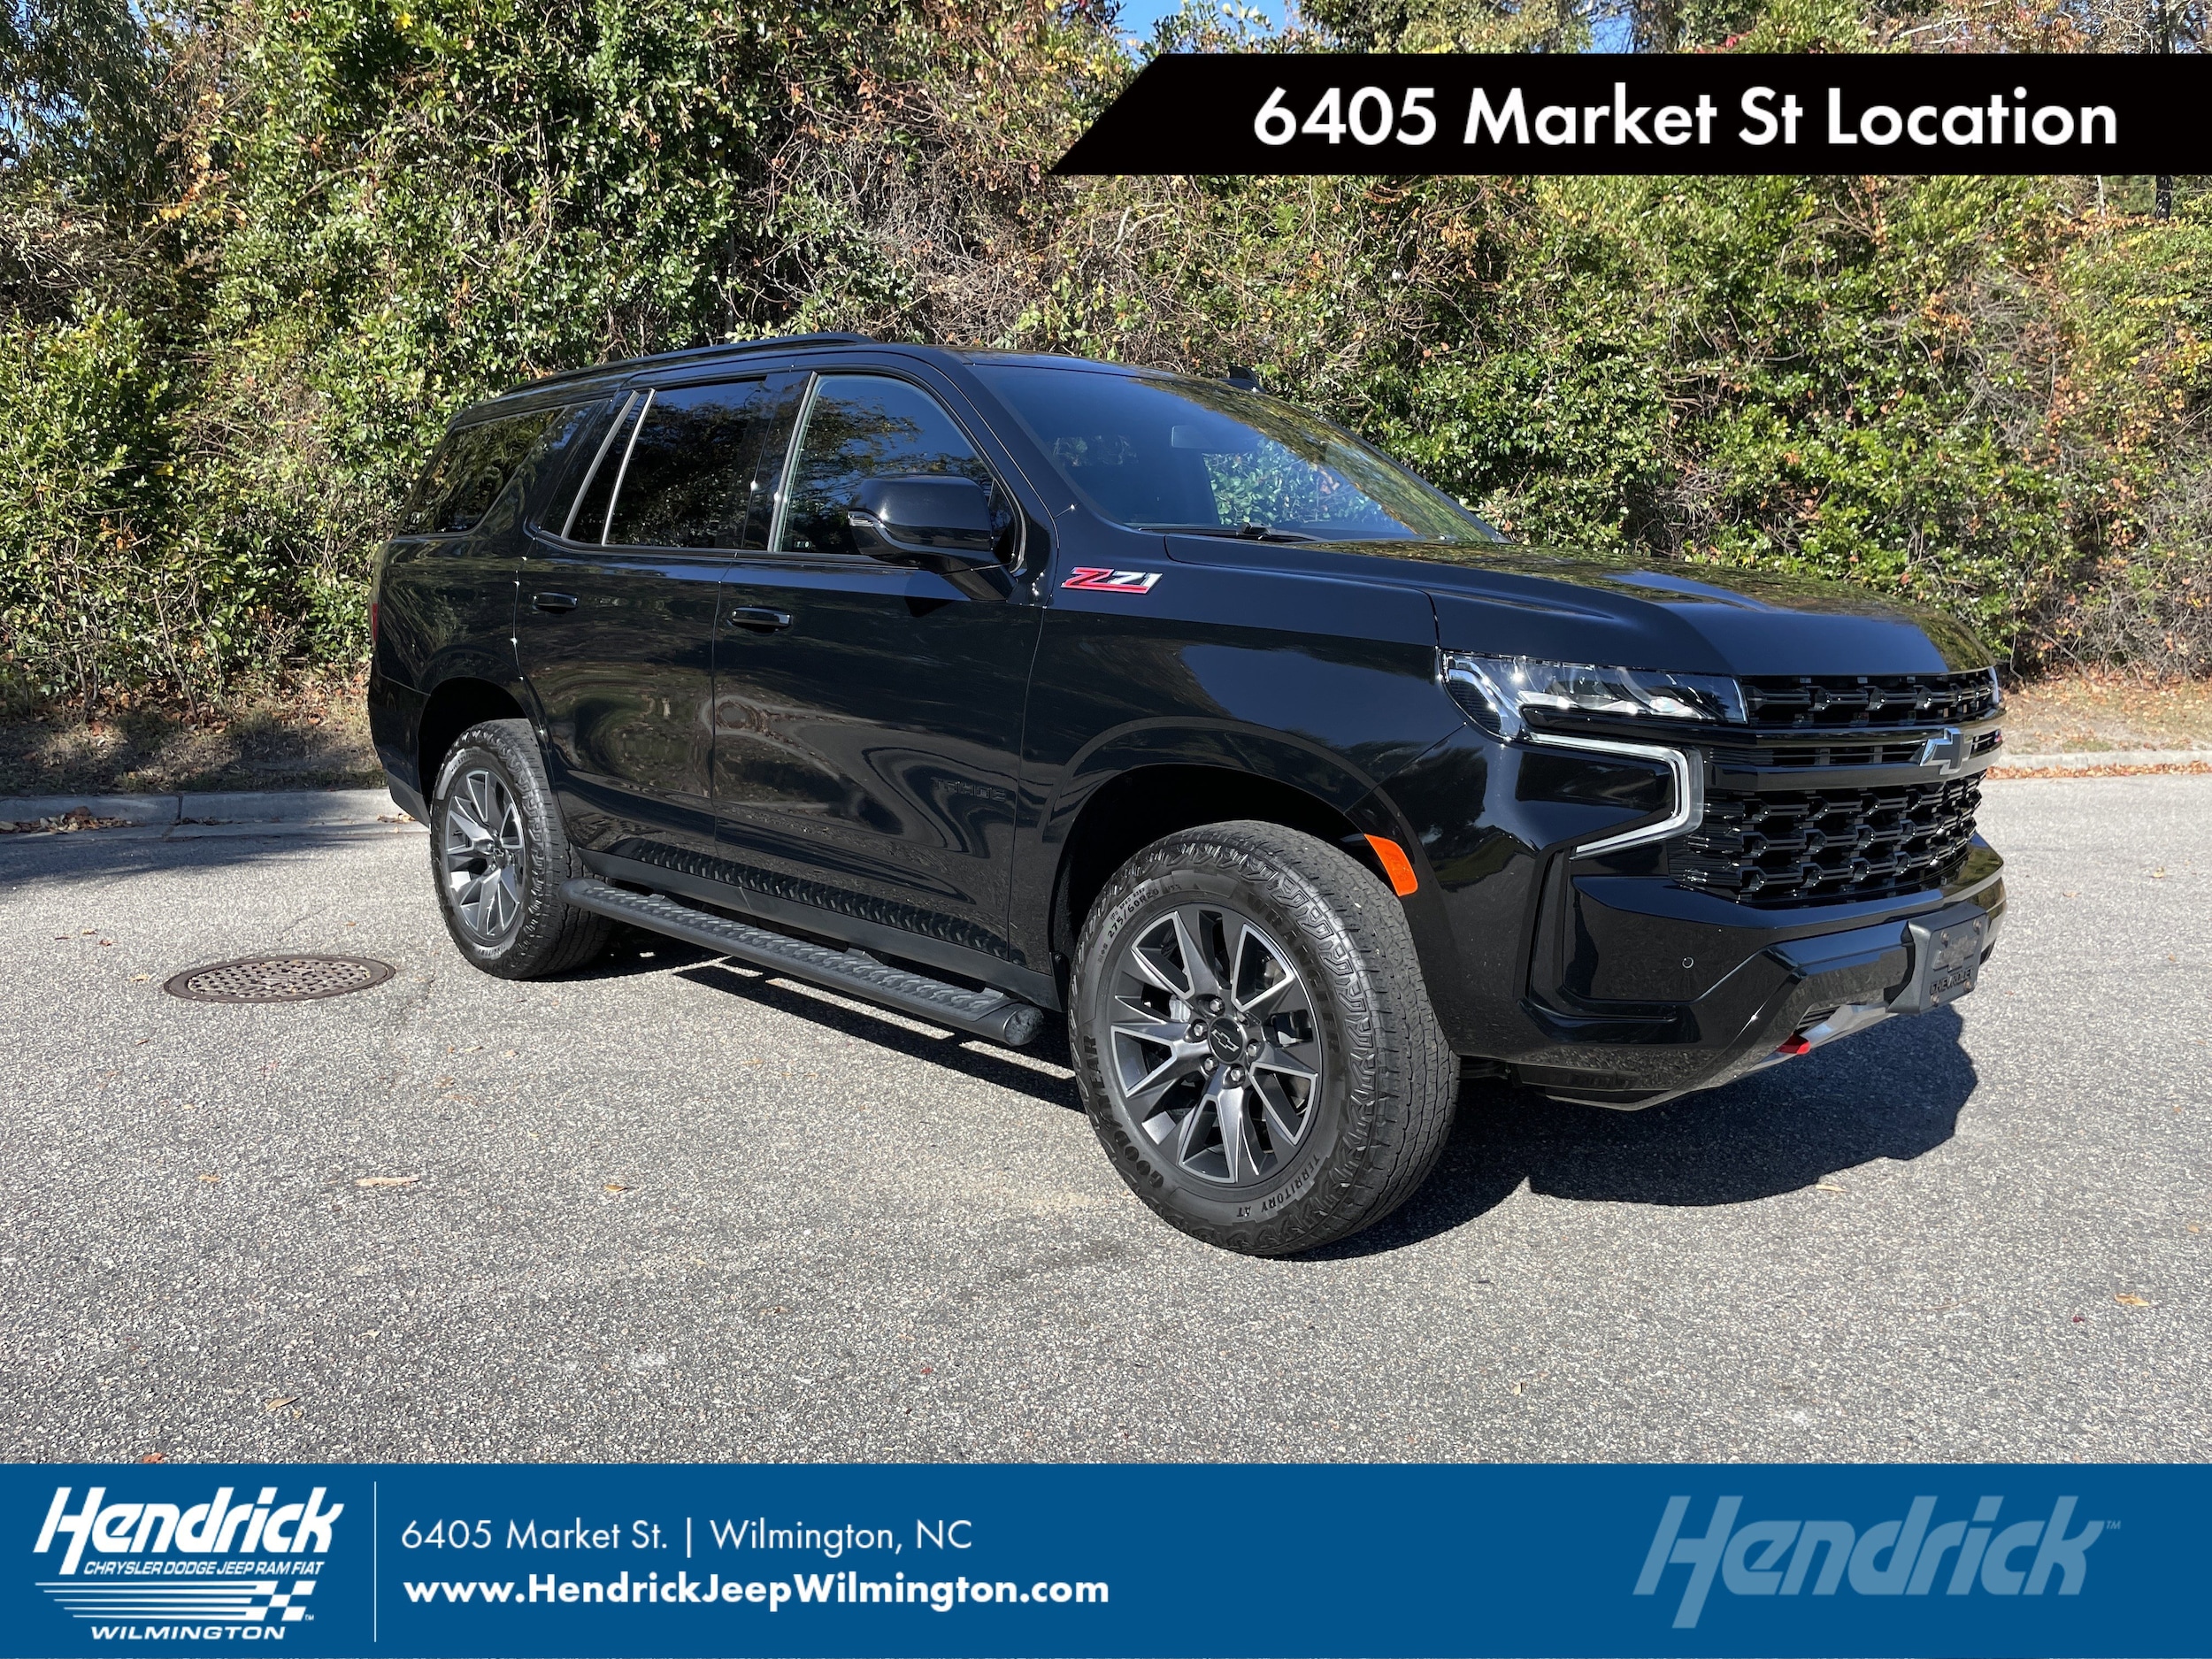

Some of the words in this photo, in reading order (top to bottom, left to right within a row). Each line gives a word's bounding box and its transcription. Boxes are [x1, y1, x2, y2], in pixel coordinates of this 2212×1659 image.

[1061, 566, 1164, 595] Z71
[1108, 887, 1160, 938] 275/60R20
[1083, 1035, 1164, 1189] GOODYEAR
[1261, 1153, 1320, 1213] TERRITORY
